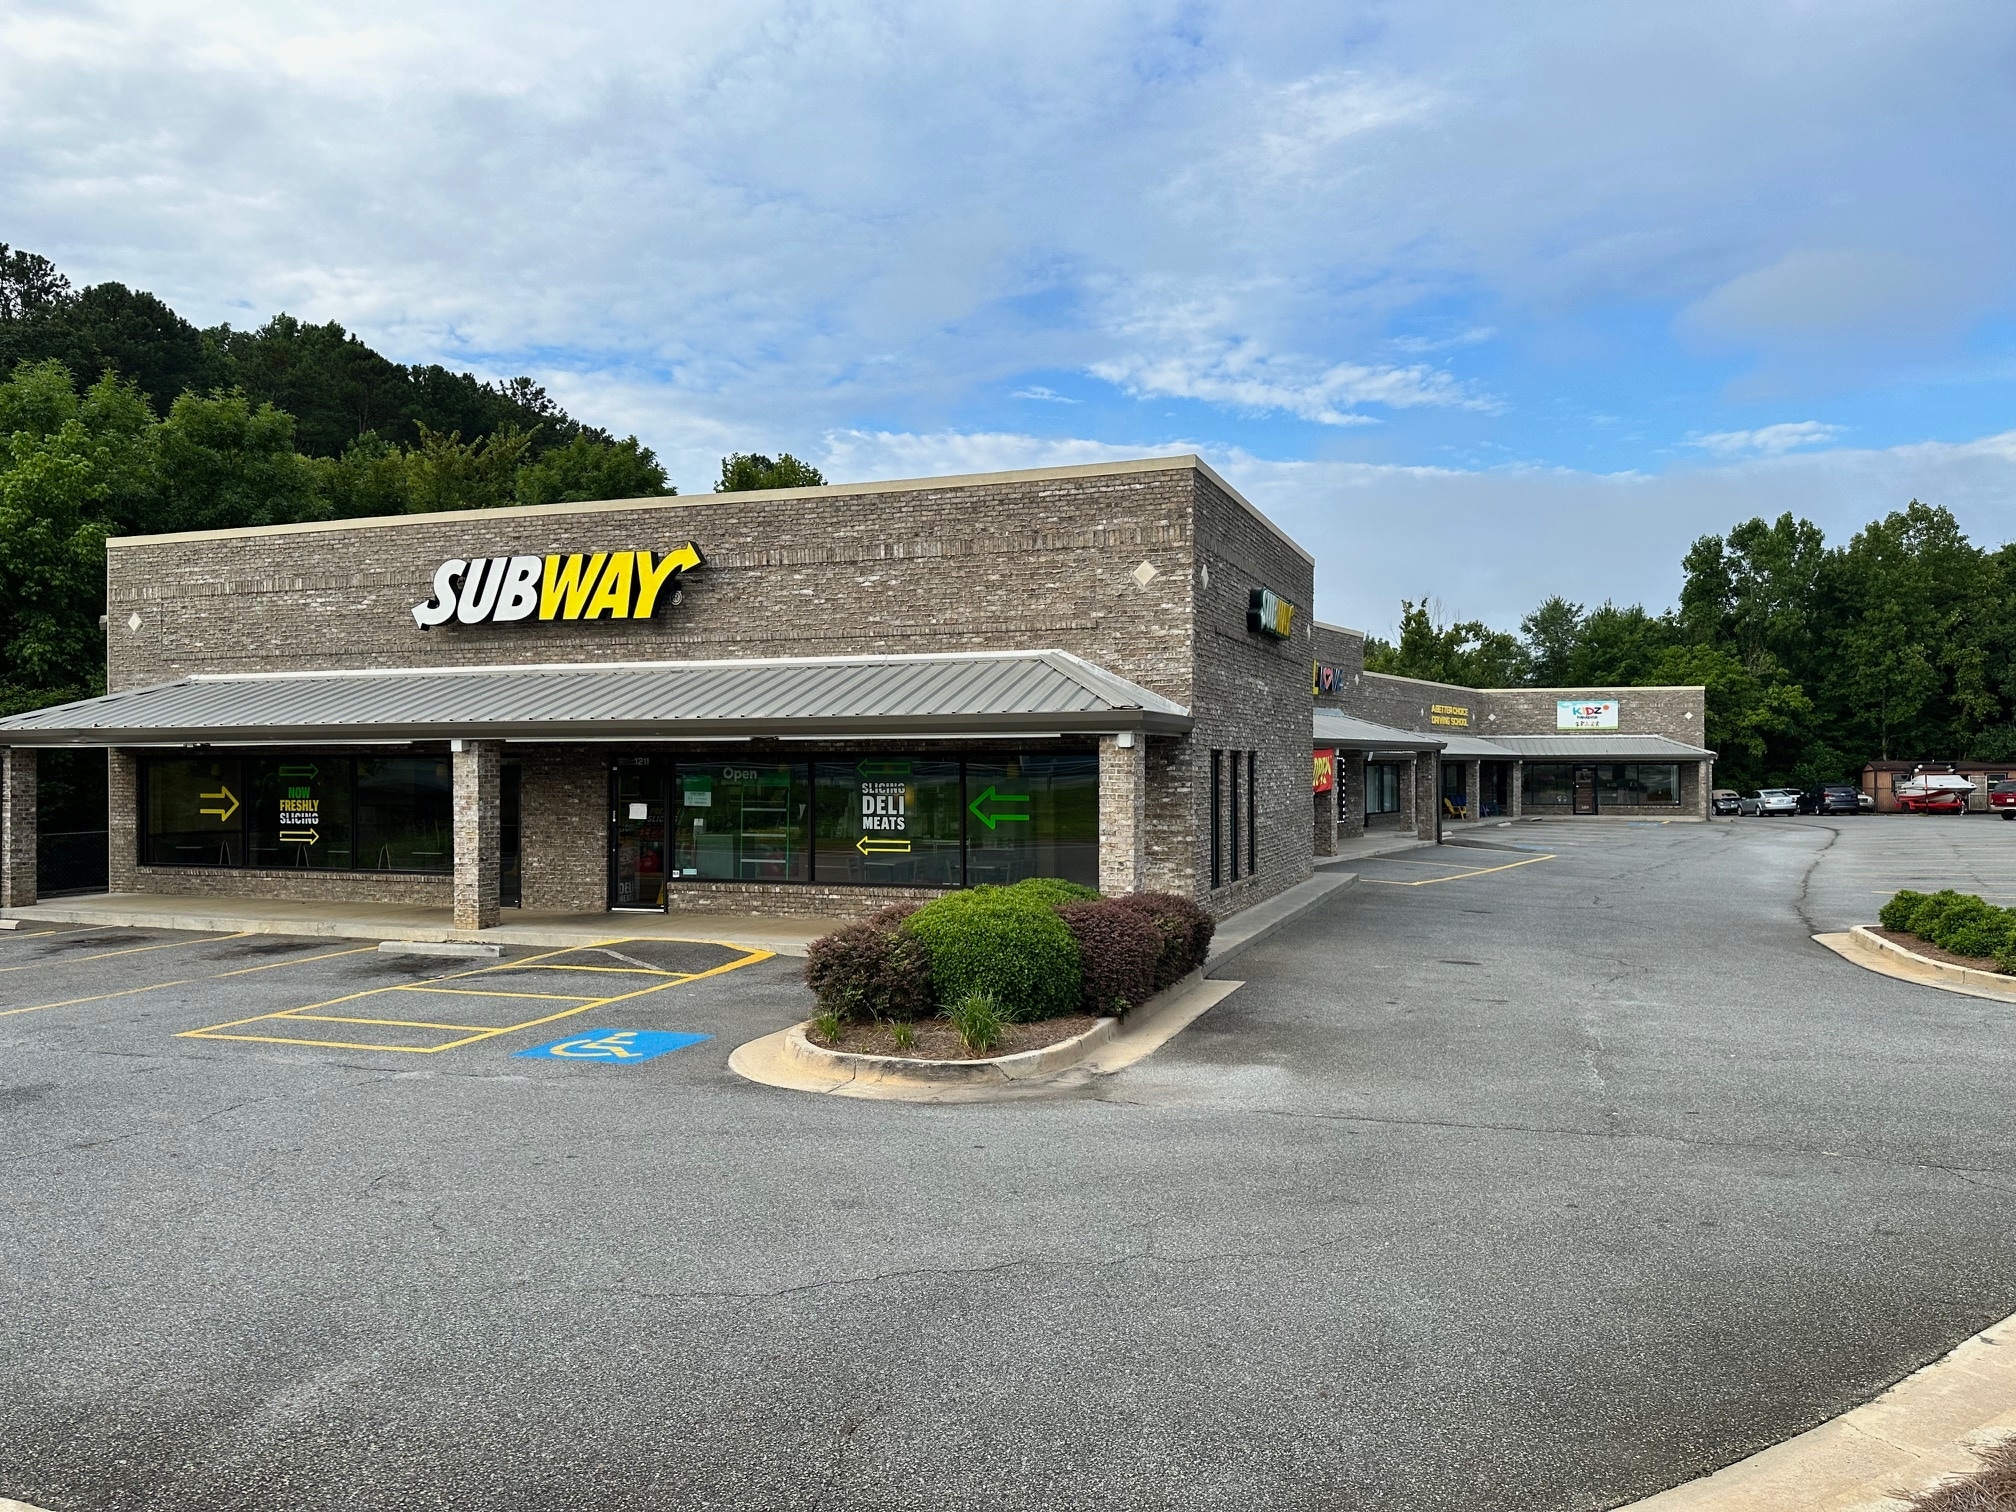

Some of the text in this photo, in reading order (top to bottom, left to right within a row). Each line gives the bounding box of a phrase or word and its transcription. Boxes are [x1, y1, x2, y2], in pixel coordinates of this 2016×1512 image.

[411, 541, 702, 630] SUBWAY
[1573, 706, 1602, 715] KIDZ
[1450, 717, 1469, 727] SCHOOL
[634, 757, 650, 766] 1211
[723, 767, 758, 782] Open
[288, 787, 310, 799] NOW
[861, 782, 906, 794] SLICING
[280, 799, 319, 811] FRESHLY
[862, 795, 905, 815] DELI
[280, 812, 319, 824] SLICING
[862, 816, 906, 830] MEATS
